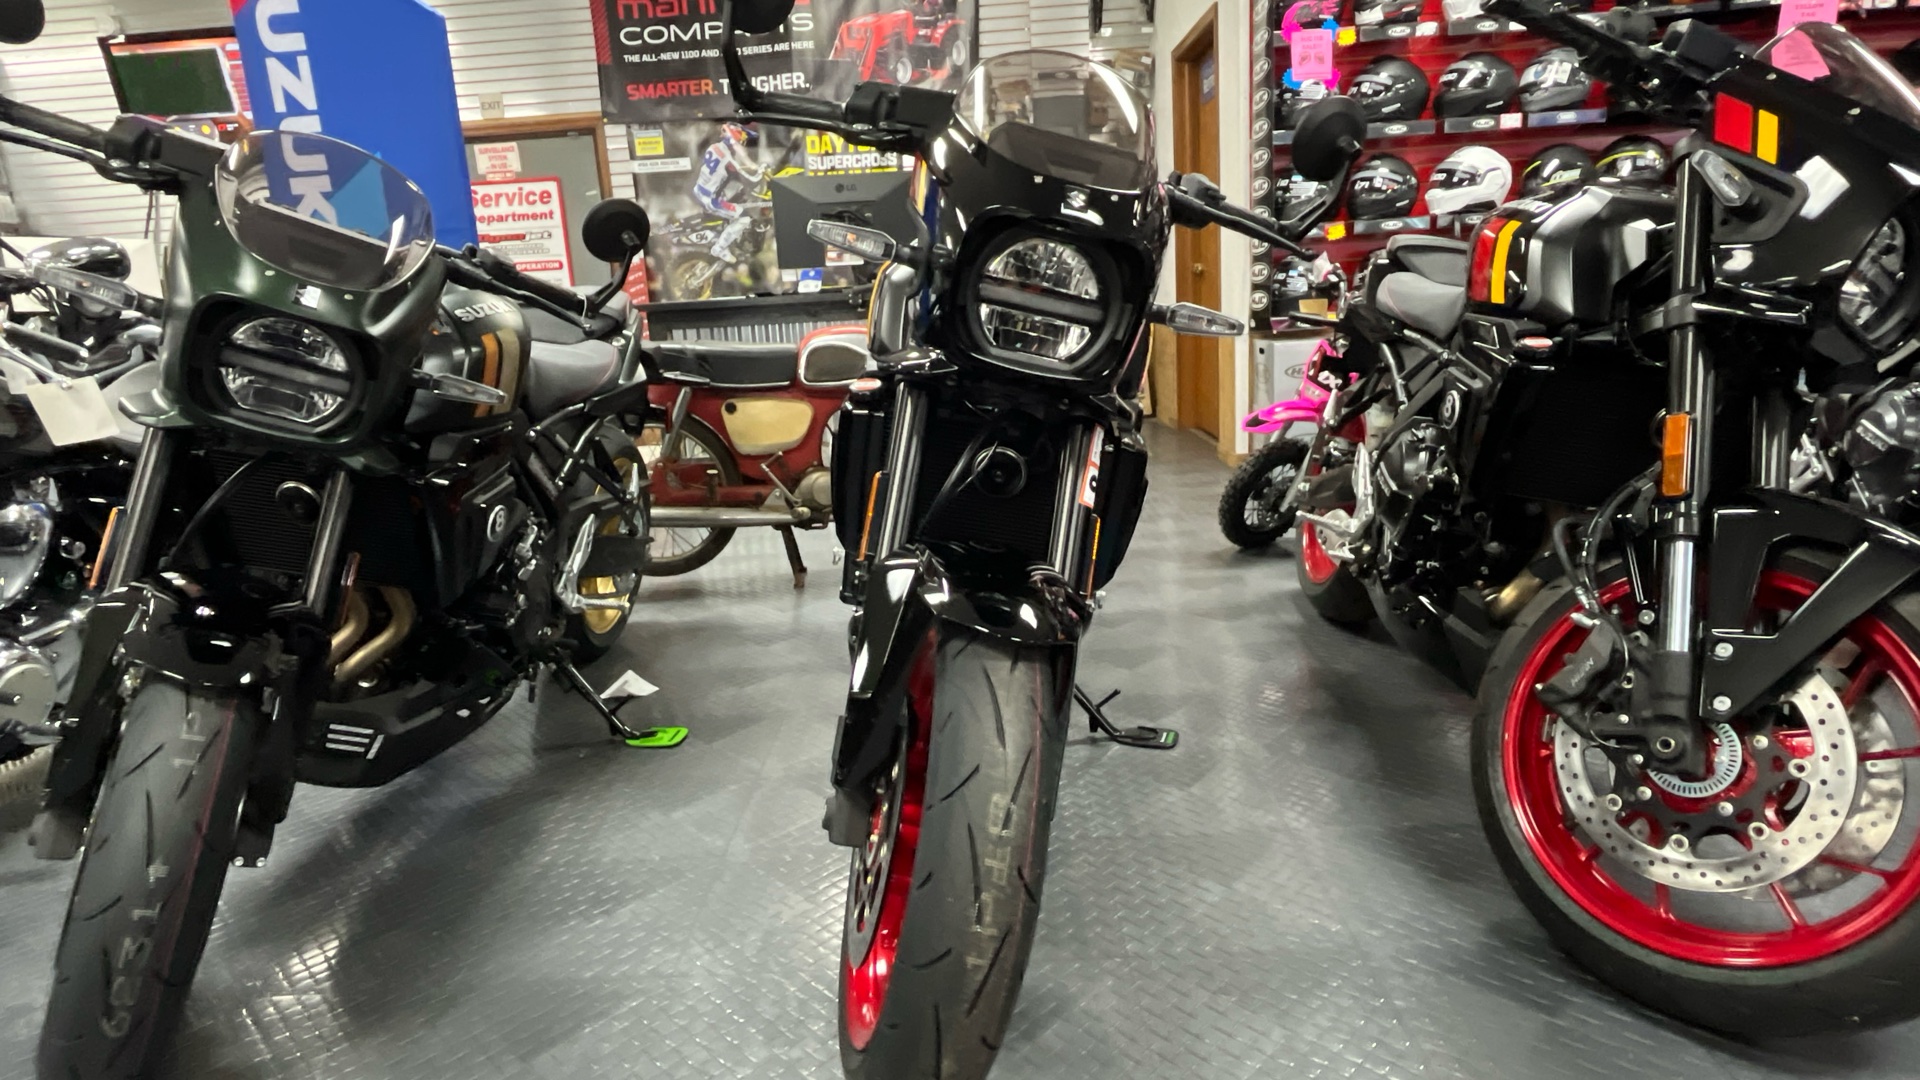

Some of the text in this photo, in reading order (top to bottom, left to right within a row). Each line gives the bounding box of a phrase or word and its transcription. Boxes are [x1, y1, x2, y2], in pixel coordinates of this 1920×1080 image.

[619, 12, 815, 46] COMPS
[623, 54, 641, 63] THE
[641, 51, 680, 62] ALL-NEW
[681, 50, 700, 59] 1100
[700, 49, 720, 58] AND
[743, 45, 772, 55] SERIES
[773, 42, 790, 52] ARE
[791, 40, 815, 50] HERE
[626, 71, 810, 100] SMARTER. TGHER.
[255, 0, 339, 227] UZUK
[481, 101, 500, 110] EXIT
[807, 152, 898, 170] SUPERCROSS
[471, 186, 552, 208] Service
[475, 209, 554, 226] epartment
[515, 262, 560, 270] OPERATION
